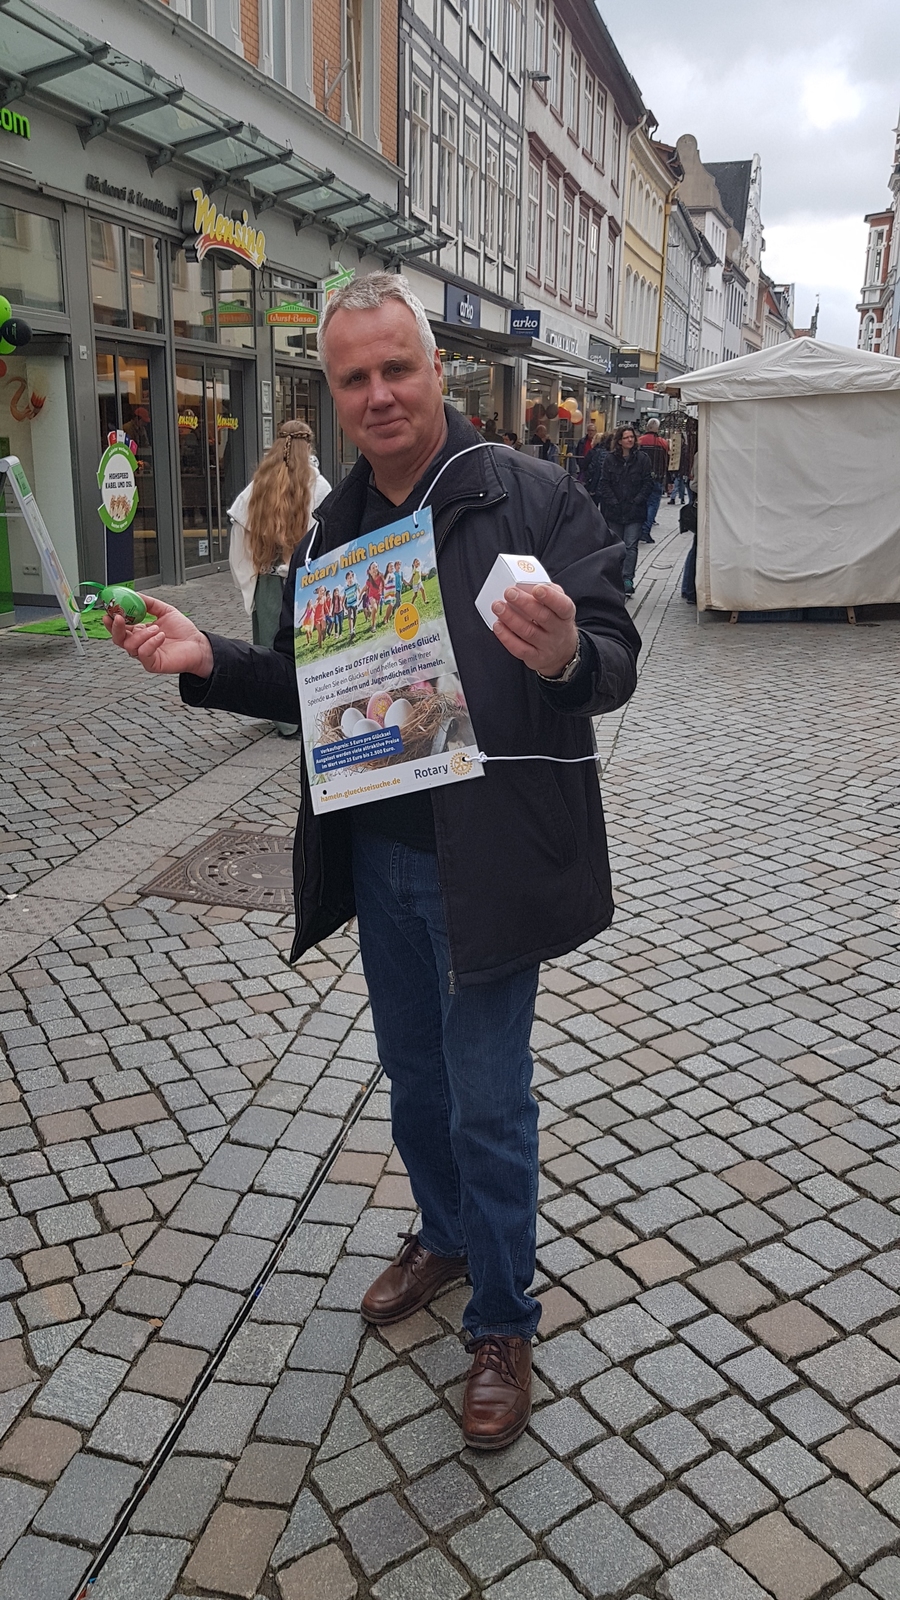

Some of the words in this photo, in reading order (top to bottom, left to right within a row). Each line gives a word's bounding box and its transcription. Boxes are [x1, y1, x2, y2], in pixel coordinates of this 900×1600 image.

[0, 107, 31, 140] om
[127, 189, 135, 204] &
[193, 187, 266, 267] Mensing
[460, 294, 474, 320] arko
[269, 313, 315, 323] Wurst-Basar
[512, 315, 538, 328] arko
[493, 411, 499, 421] 2
[109, 472, 129, 480] HIGHSPEED
[105, 481, 117, 489] KABEL
[301, 561, 339, 588] Rotary
[340, 547, 367, 569] hilft
[304, 670, 334, 685] Schenken
[334, 665, 345, 675] Sie
[353, 653, 379, 668] OSTERN
[379, 649, 391, 659] ein
[391, 641, 416, 655] kleines
[416, 633, 441, 647] Glück!
[314, 683, 332, 693] Kaufen
[332, 679, 340, 688] Sie
[340, 676, 348, 685] ein
[369, 664, 381, 675] und
[381, 660, 398, 671] helfen
[398, 657, 407, 666] Sie
[407, 654, 418, 663] mit
[417, 650, 432, 659] Ihrer
[307, 695, 326, 707] Spende
[325, 692, 336, 700] u.a.
[336, 684, 359, 696] Kindern
[358, 680, 370, 689] und
[370, 667, 411, 686] Jugendlichen
[410, 665, 418, 673] in
[417, 658, 446, 671] Hameln.
[363, 736, 372, 744] pro
[336, 750, 352, 759] werden
[362, 741, 385, 751] attraktive
[328, 760, 338, 768] Wert
[414, 764, 449, 779] Rotary
[320, 777, 401, 802] hameln.glueckseisuche.de
